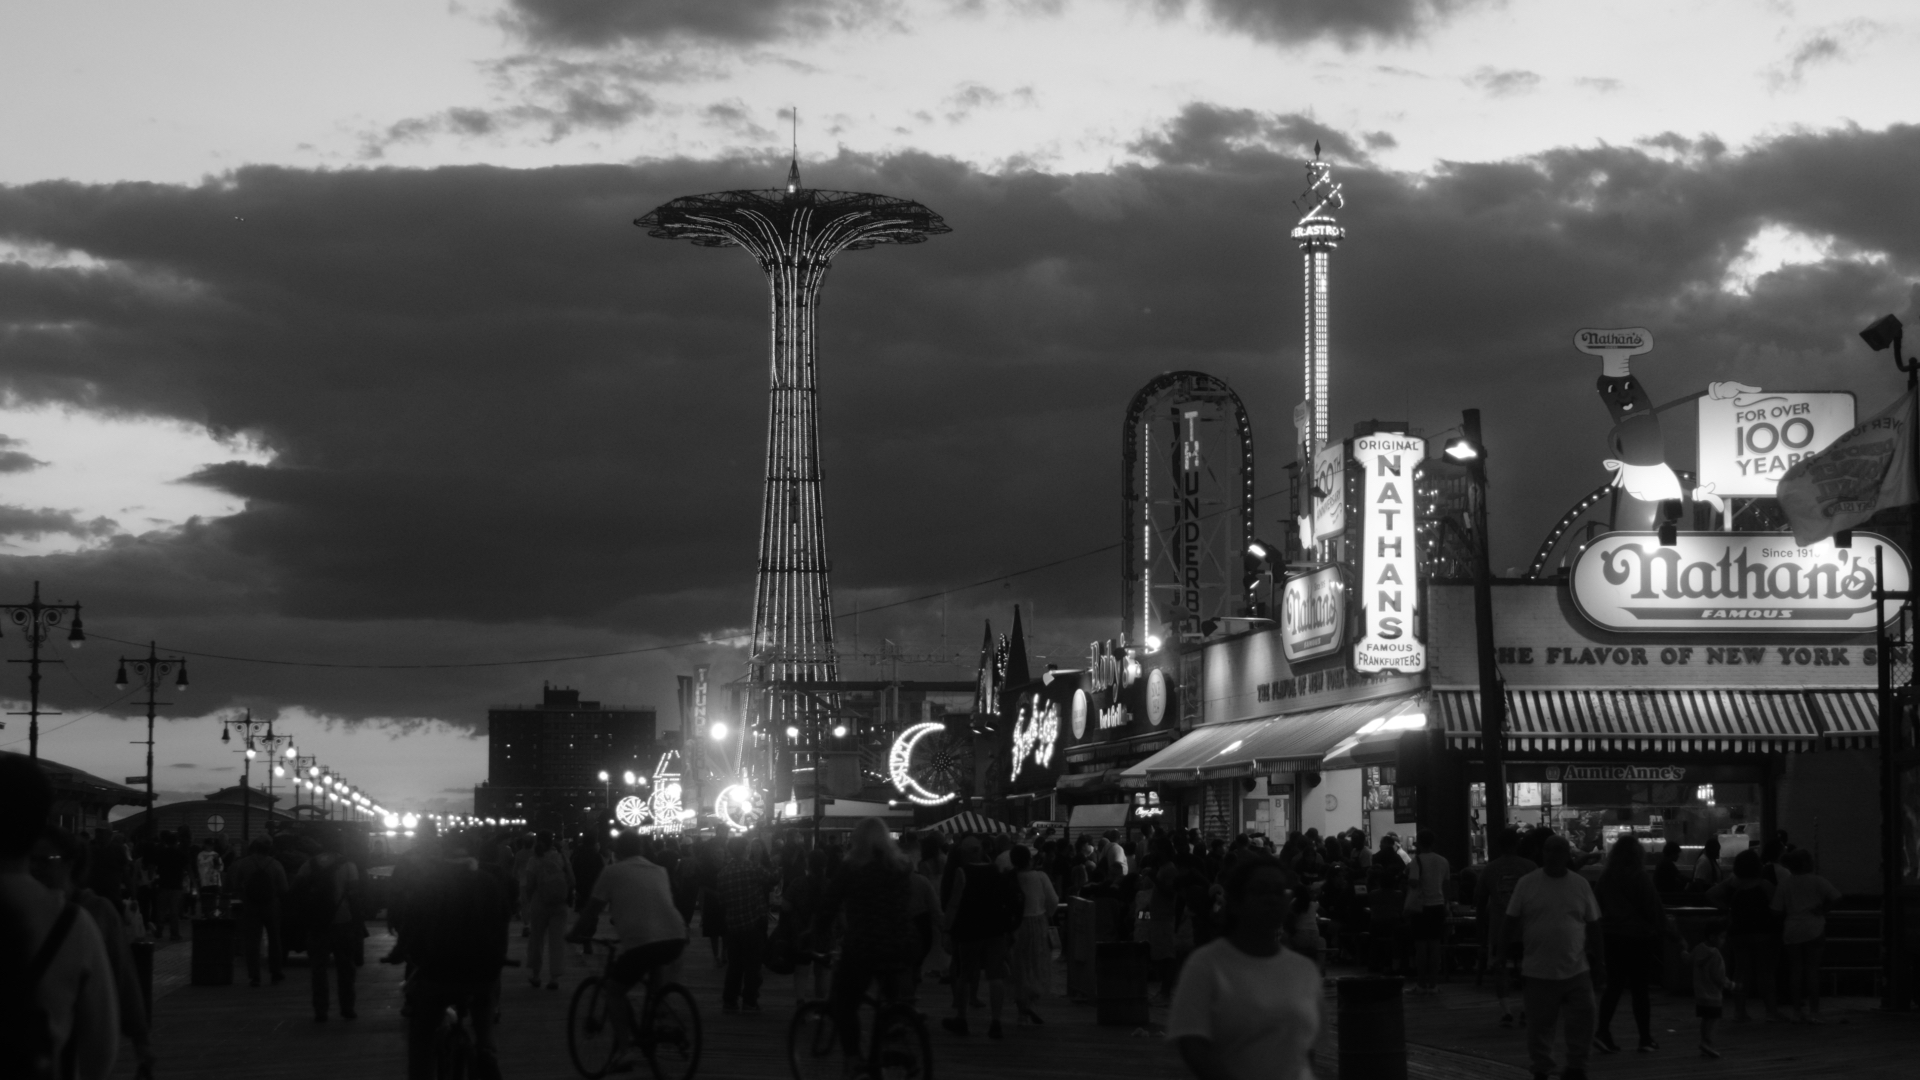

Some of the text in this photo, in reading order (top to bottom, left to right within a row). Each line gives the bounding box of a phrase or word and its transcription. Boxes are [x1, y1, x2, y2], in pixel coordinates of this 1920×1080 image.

[1581, 331, 1643, 345] Nathan's
[1735, 402, 1811, 424] FOR OVER
[1358, 438, 1420, 452] ORIGINAL
[1736, 417, 1815, 457] 100
[1376, 454, 1403, 640] NATHANS
[1761, 548, 1825, 559] Since 191
[1600, 542, 1877, 601] Nathan's
[1286, 584, 1337, 636] Nathan's
[1701, 609, 1793, 619] FAMOUS
[1366, 643, 1414, 653] FAMOUS
[1494, 646, 1534, 665] HE
[1547, 646, 1649, 666] FLAVOR
[1660, 646, 1694, 666] OF
[1706, 646, 1767, 665] NEW
[1778, 646, 1850, 666] YORK
[1357, 651, 1422, 668] FRANKFURTERS
